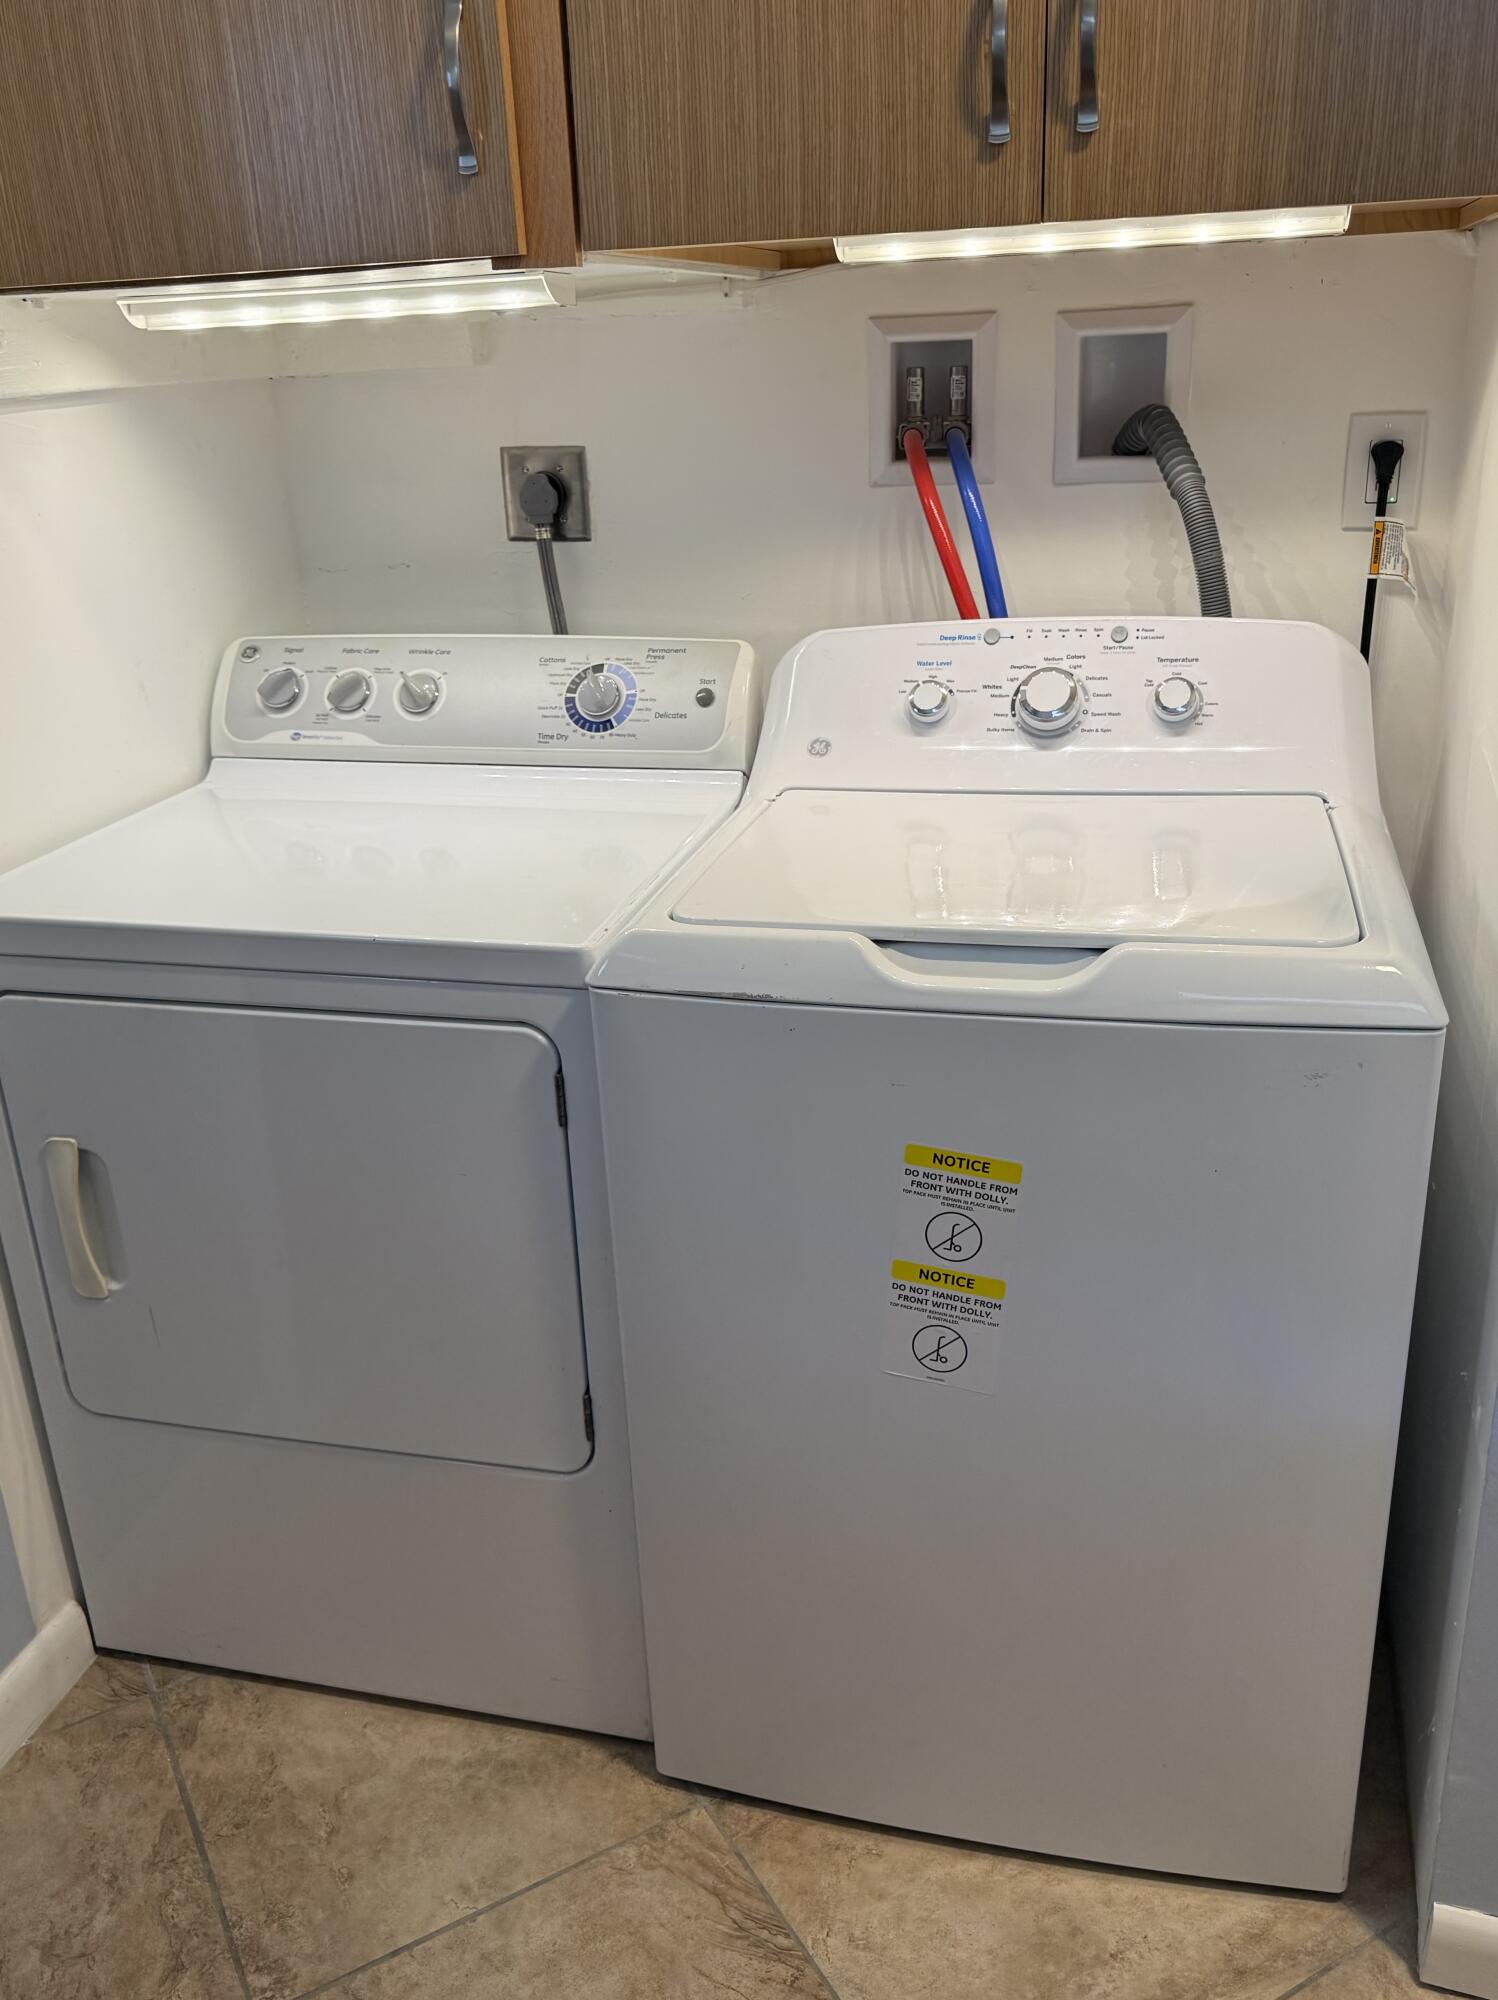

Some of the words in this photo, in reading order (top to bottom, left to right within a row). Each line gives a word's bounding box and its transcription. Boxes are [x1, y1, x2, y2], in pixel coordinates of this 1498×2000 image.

[538, 732, 555, 740] Time
[556, 733, 569, 741] Dry
[932, 1152, 991, 1174] NOTICE
[904, 1168, 920, 1177] DO
[922, 1171, 944, 1182] NOT
[946, 1175, 987, 1190] HANDLE
[989, 1184, 1018, 1196] FROM
[910, 1180, 944, 1192] FRONT
[945, 1186, 972, 1198] WITH
[974, 1192, 1009, 1205] DOLLY.
[942, 1195, 962, 1203] REMAIN
[969, 1200, 986, 1208] PLACE
[986, 1204, 1002, 1212] UNTIL
[946, 1202, 975, 1212] INSTALLED.
[918, 1268, 976, 1289] NOTICE
[891, 1282, 906, 1291] DO
[909, 1286, 930, 1296] NOT
[932, 1290, 972, 1305] HANDLE
[973, 1299, 1002, 1311] FROM
[897, 1293, 930, 1306] FRONT
[931, 1300, 957, 1312] WITH
[959, 1306, 993, 1320] DOLLY.
[928, 1309, 948, 1317] REMAIN
[955, 1315, 971, 1323] PLACE
[971, 1318, 986, 1326] UNTIL
[932, 1316, 959, 1325] INSTALLED.
